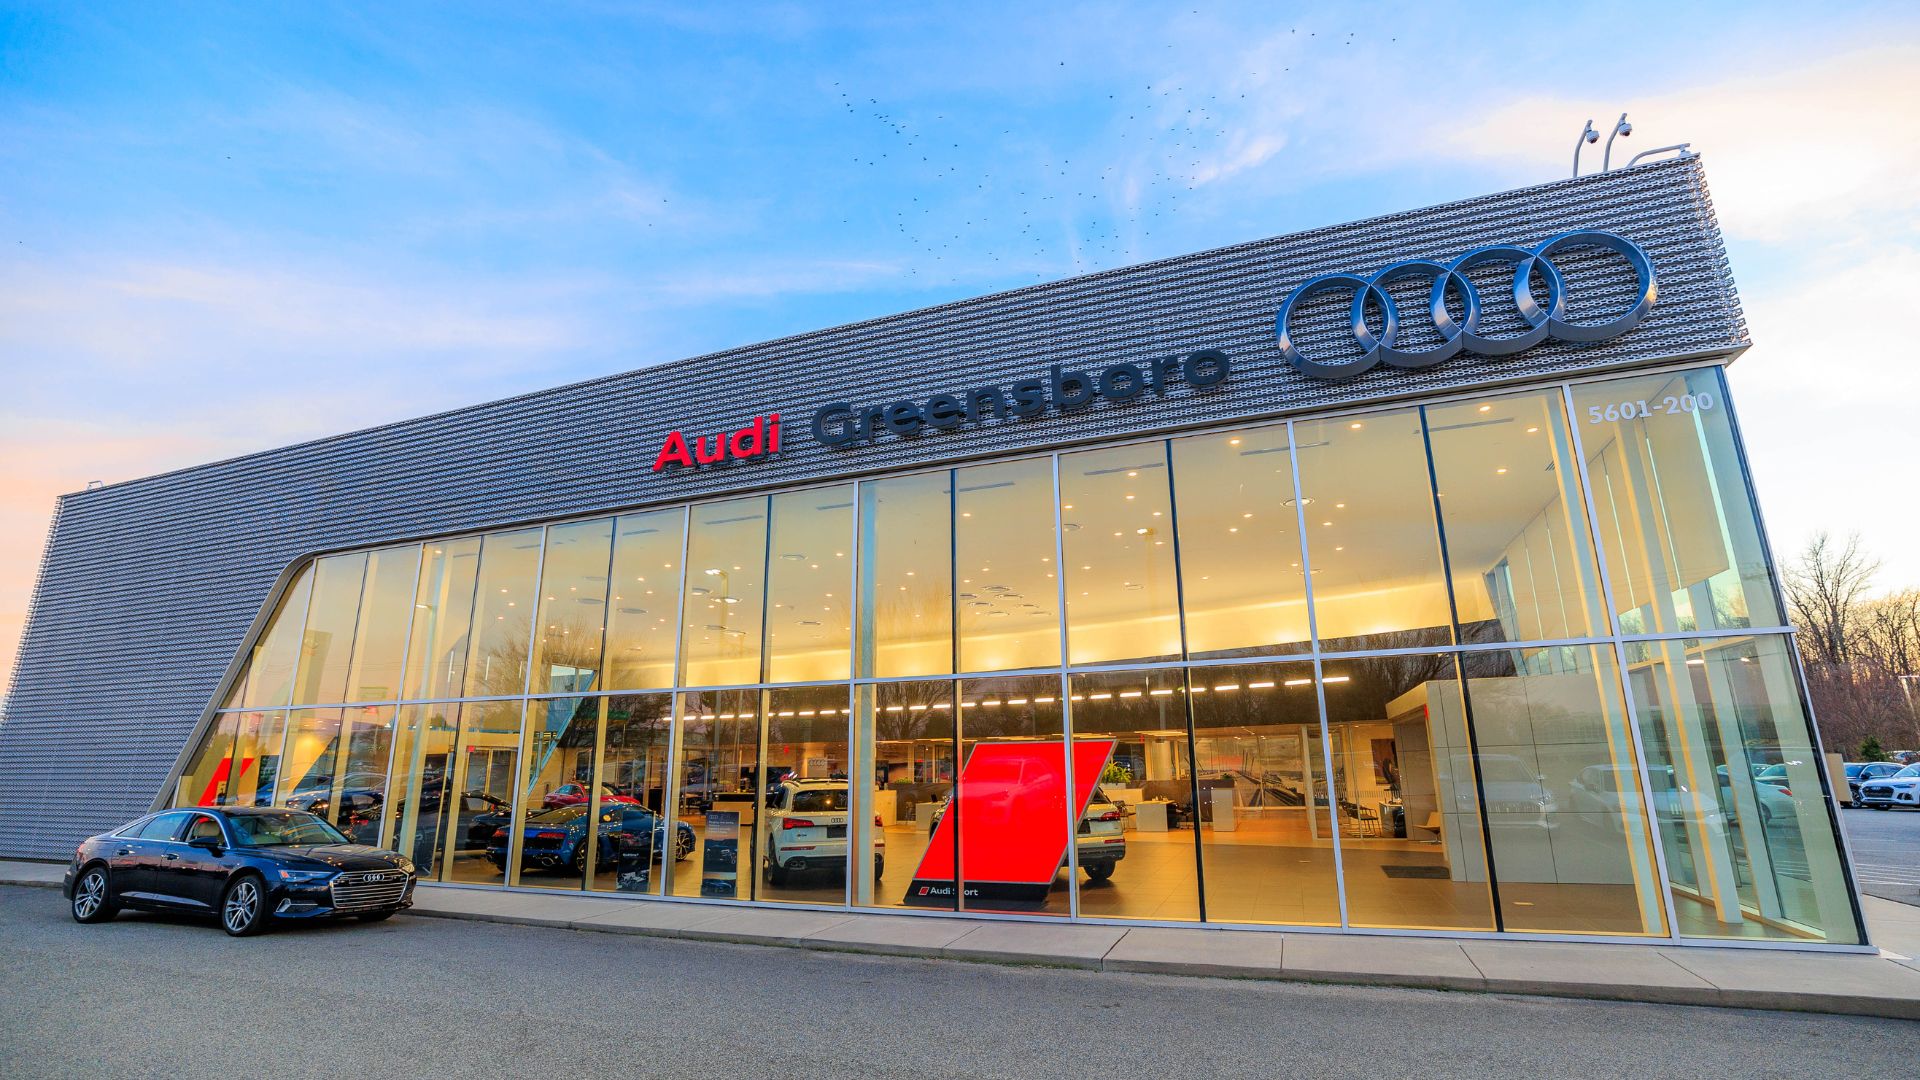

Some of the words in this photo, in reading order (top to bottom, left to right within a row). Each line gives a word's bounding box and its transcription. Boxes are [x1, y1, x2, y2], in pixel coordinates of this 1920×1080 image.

[652, 413, 781, 472] Audi
[811, 348, 1230, 446] Greensboro
[1588, 392, 1714, 424] 5601-200
[930, 887, 950, 895] Audi
[952, 888, 979, 896] ort
